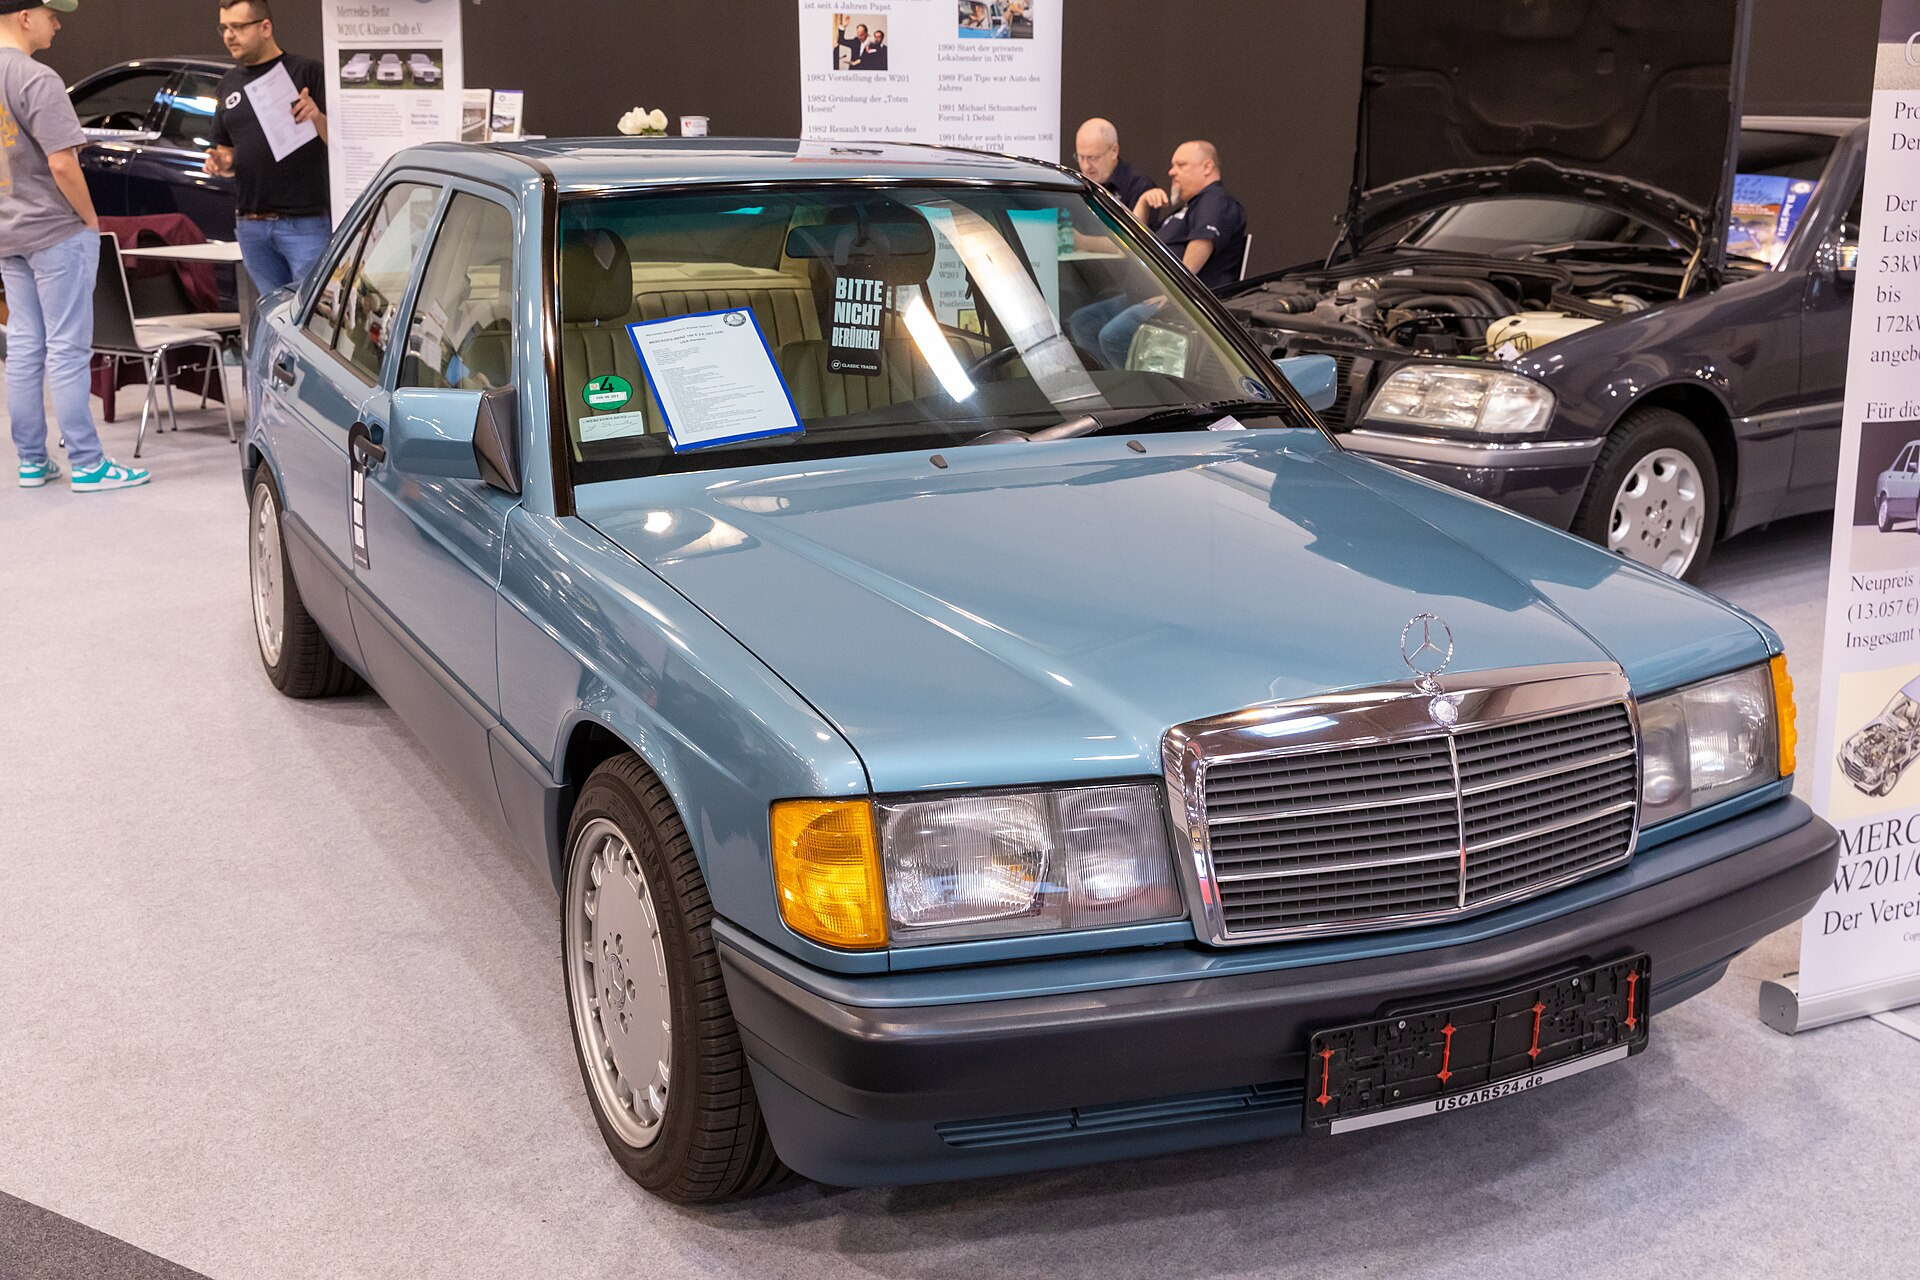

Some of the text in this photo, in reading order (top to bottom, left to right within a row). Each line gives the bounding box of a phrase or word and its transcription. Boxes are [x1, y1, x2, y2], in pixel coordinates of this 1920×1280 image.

[870, 3, 891, 12] Papst
[992, 44, 1024, 53] privaten
[828, 74, 872, 83] Vorstellung
[958, 74, 972, 82] Fiat
[974, 74, 991, 83] Tipo
[828, 95, 868, 104] Gründung
[1885, 194, 1918, 212] Der
[835, 277, 884, 302] BITTE
[1876, 285, 1901, 303] bis
[834, 301, 882, 326] NICHT
[832, 326, 880, 350] BERÜHREN
[1870, 345, 1920, 367] angeb
[600, 377, 614, 392] 4
[1866, 402, 1895, 418] Für
[1850, 570, 1914, 594] Neupreis
[1846, 627, 1914, 651] Insgesamt
[1834, 849, 1920, 895] W201/
[1822, 910, 1862, 936] Der
[1435, 1076, 1543, 1112] USCARS24.de
